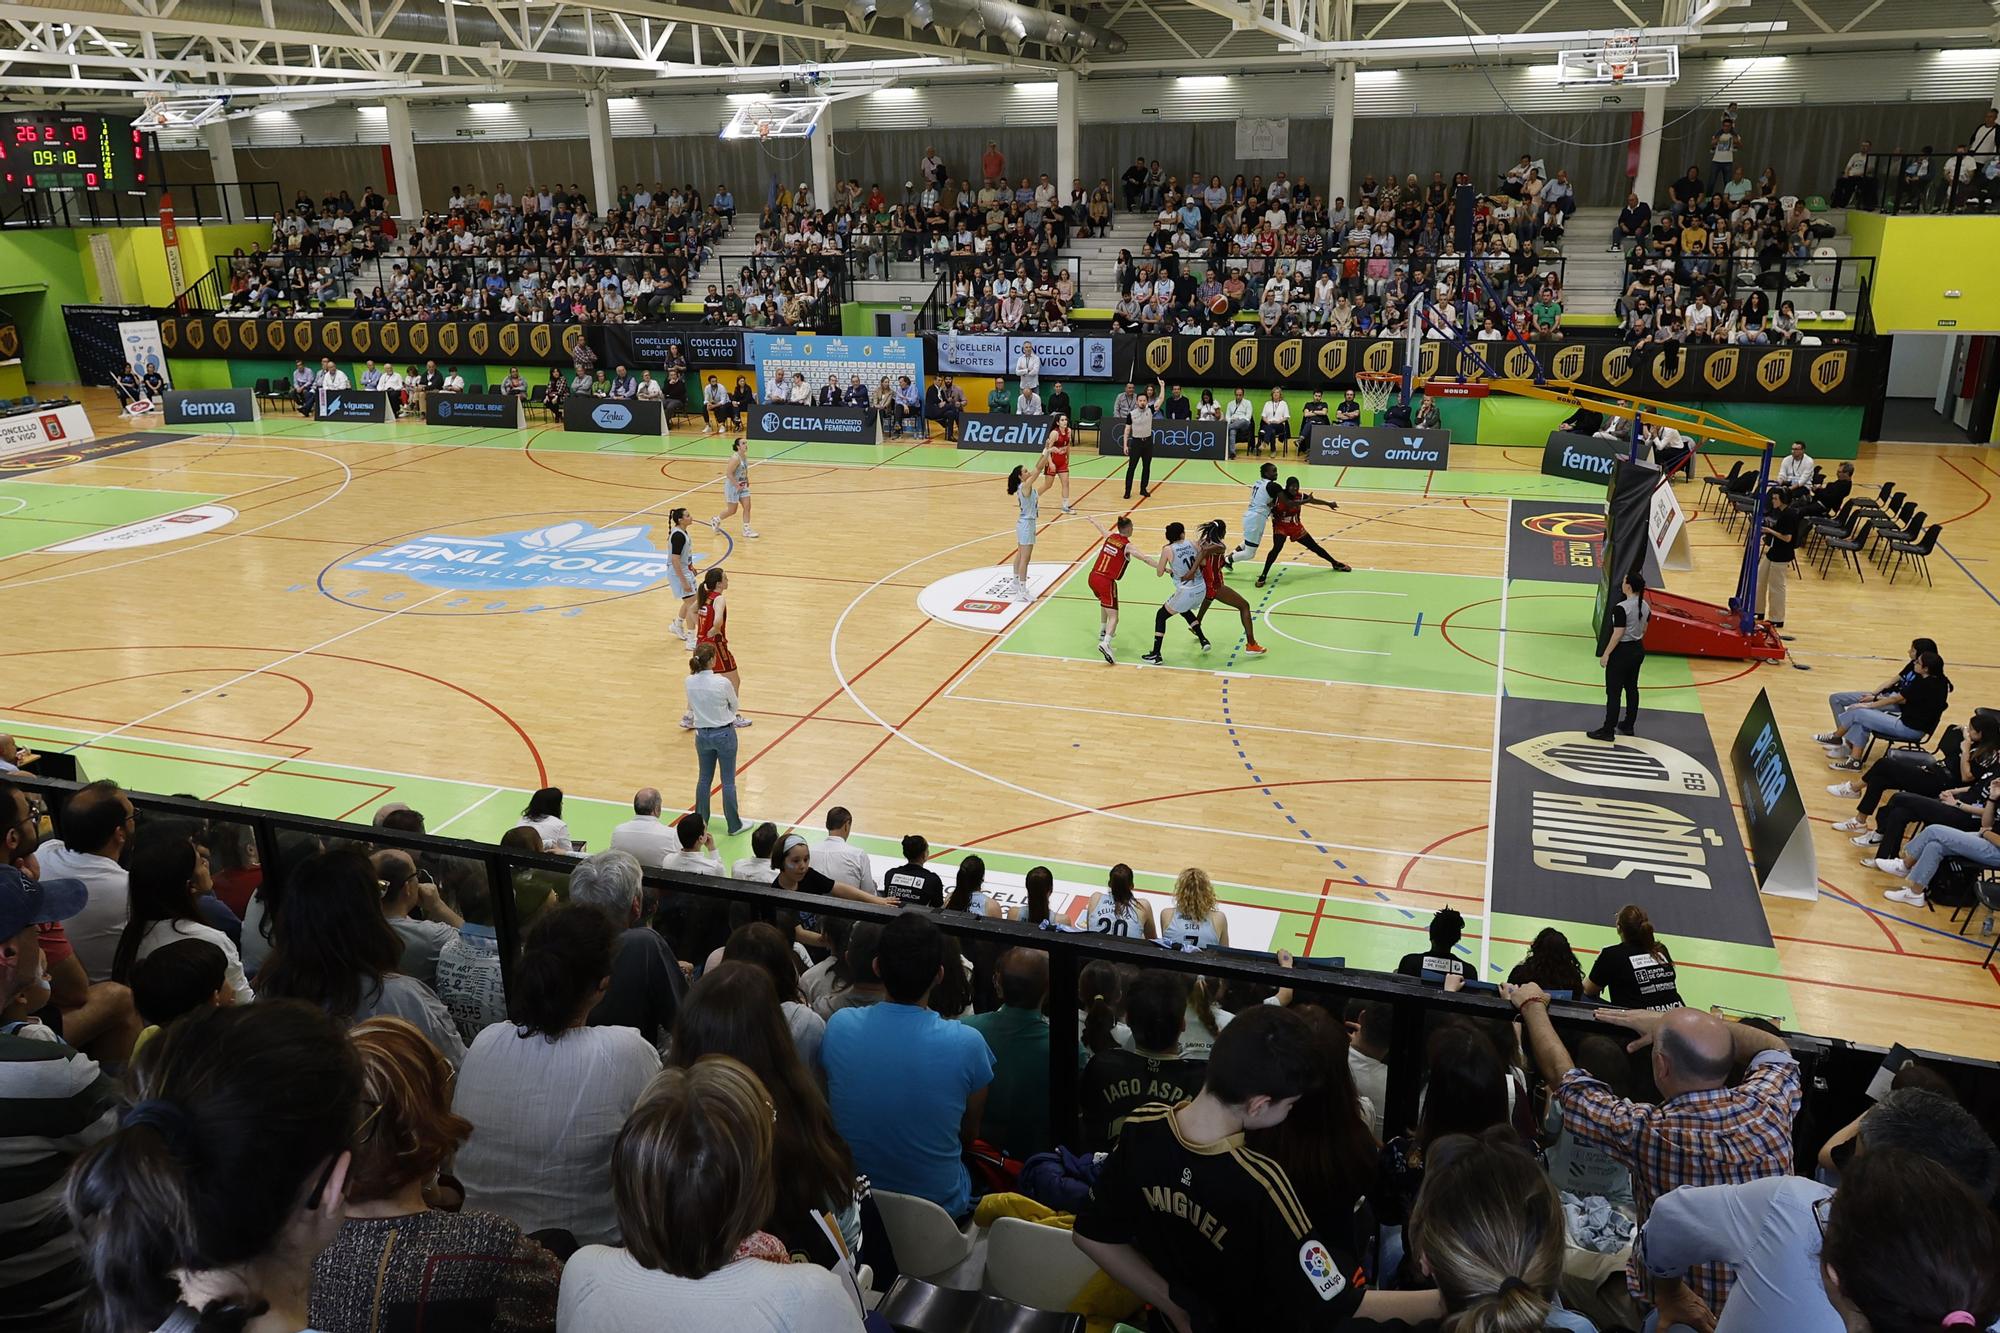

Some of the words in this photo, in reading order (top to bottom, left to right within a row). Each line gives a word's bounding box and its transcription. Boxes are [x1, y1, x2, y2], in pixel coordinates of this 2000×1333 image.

[16, 126, 38, 141] 26
[45, 126, 55, 140] 2
[72, 125, 88, 141] 19
[33, 150, 76, 165] 09:18
[86, 173, 97, 186] 0
[635, 337, 682, 346] CONCELLERÍA
[690, 338, 737, 348] CONCELLO
[942, 343, 1001, 352] CNCELLERÍA
[697, 348, 709, 357] DE
[712, 348, 733, 358] VIGO
[1152, 345, 1168, 368] 100
[1193, 345, 1209, 369] 100
[1236, 346, 1252, 369] 100
[1280, 347, 1296, 370] 100
[1324, 348, 1341, 371] 100
[1370, 348, 1387, 372] 100
[1510, 350, 1528, 376] 100
[1560, 351, 1578, 377] 100
[1711, 357, 1731, 383] 100
[1764, 358, 1784, 384] 100
[1818, 360, 1839, 386] 100
[181, 399, 236, 416] femxa
[782, 416, 823, 431] CELTA
[824, 418, 862, 426] BALONCESTO
[5, 436, 16, 444] DE
[17, 432, 36, 441] VIGO
[964, 420, 1048, 445] Recalvi
[1385, 449, 1439, 462] amura
[381, 544, 512, 565] FINAL
[515, 554, 668, 577] FOUR
[1098, 554, 1111, 573] 11
[389, 562, 436, 571] LF
[436, 567, 600, 585] CHALLENGE
[1681, 771, 1706, 792] FEB
[1098, 917, 1128, 936] 20
[1101, 1078, 1141, 1104] IAGO
[1141, 1185, 1229, 1252] MIGUEL
[1319, 1273, 1342, 1293] LaLiga
